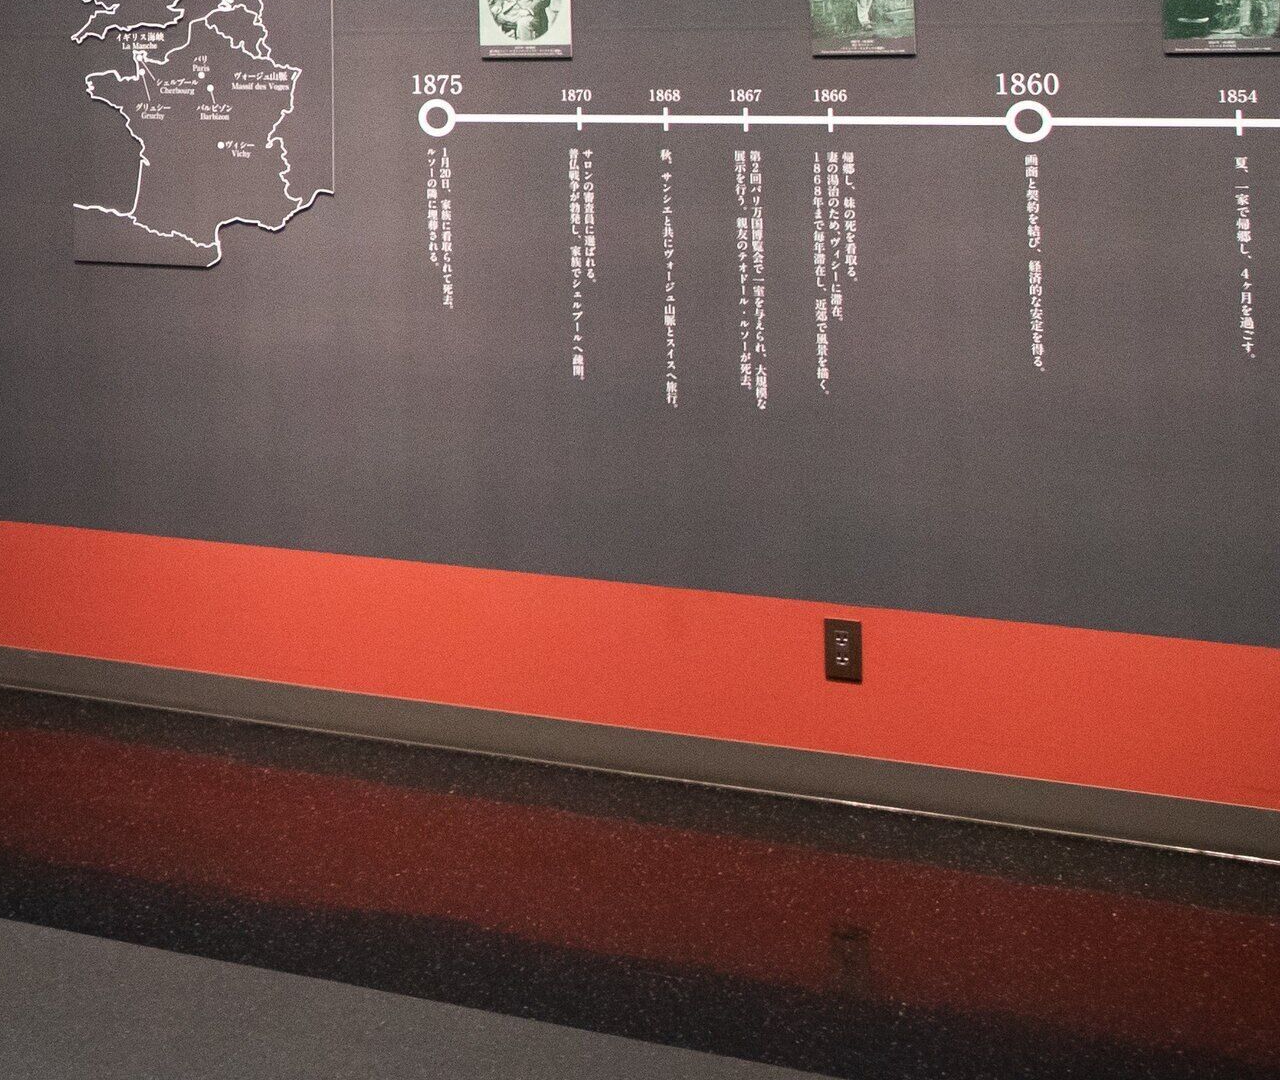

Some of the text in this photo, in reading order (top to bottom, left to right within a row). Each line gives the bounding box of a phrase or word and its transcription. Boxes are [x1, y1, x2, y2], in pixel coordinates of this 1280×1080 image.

[116, 32, 165, 42] イギリス海峡
[122, 42, 158, 50] La Manche
[193, 55, 208, 64] パリ
[192, 64, 211, 72] Paris
[233, 71, 288, 81] ヴォージュ山脈
[156, 78, 199, 87] シェルブール
[231, 82, 253, 91] Massif
[254, 82, 267, 91] des
[412, 73, 464, 96] 1875
[996, 72, 1060, 96] 1860
[159, 86, 195, 96] Cherbourg
[561, 88, 592, 102] 1870
[649, 88, 682, 102] 1868
[730, 88, 762, 103] 1867
[814, 88, 848, 103] 1866
[1219, 89, 1258, 104] 1854
[136, 102, 171, 112] グリュシー
[196, 103, 233, 113] バルビゾン
[200, 112, 230, 121] Barbizon
[225, 140, 255, 150] ヴィシー
[231, 149, 251, 159] Vichy
